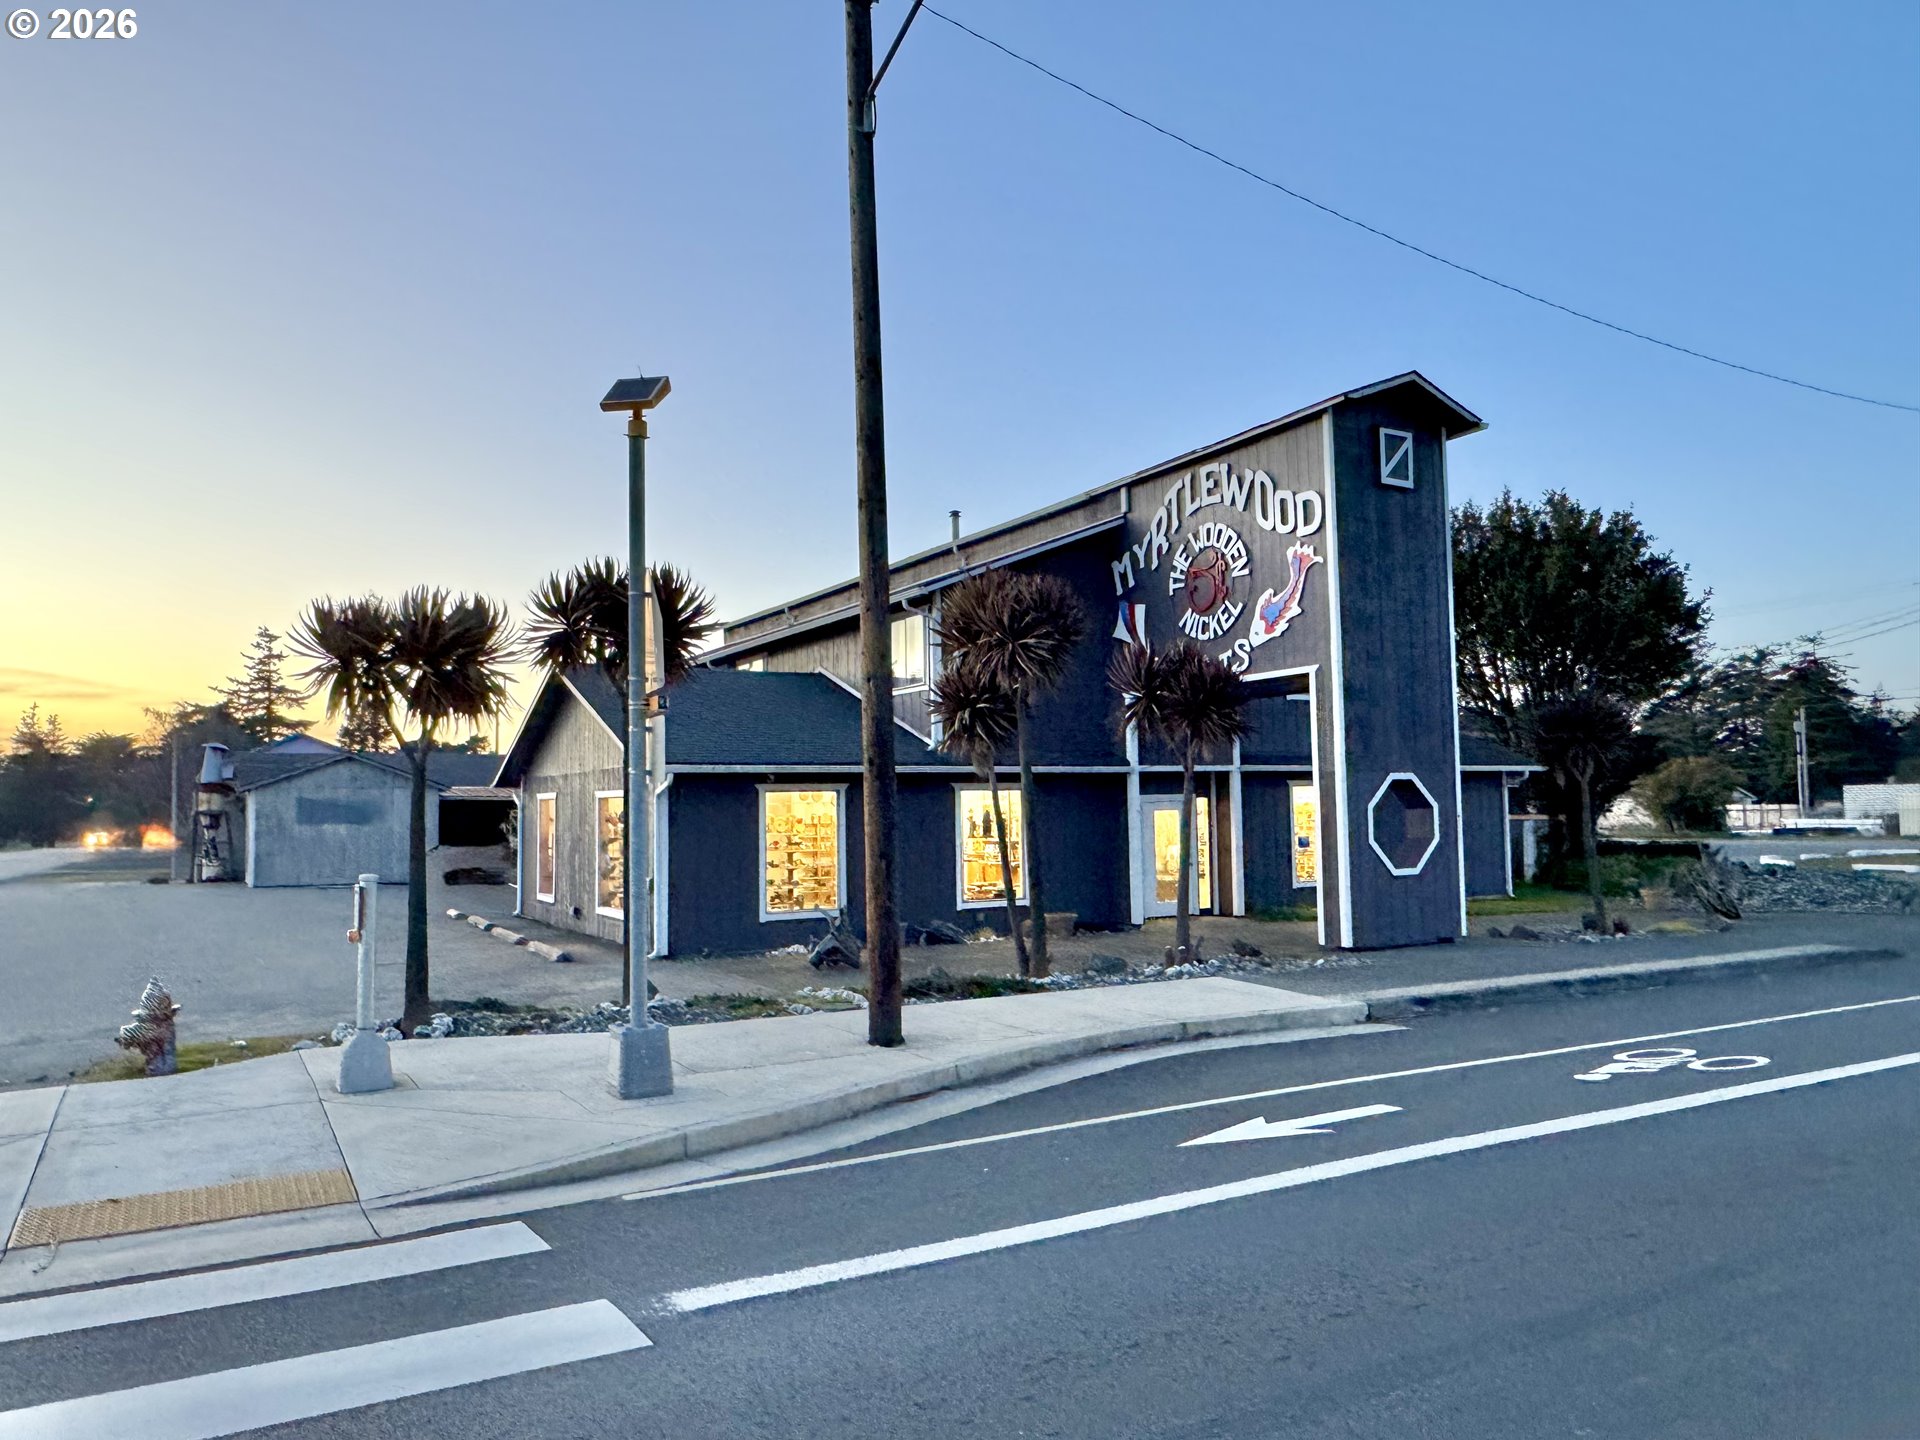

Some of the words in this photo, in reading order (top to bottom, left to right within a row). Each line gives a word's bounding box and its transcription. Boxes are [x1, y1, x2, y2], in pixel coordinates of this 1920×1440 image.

[1110, 462, 1323, 597] MYRTLEWOOD
[1169, 543, 1193, 596] THE
[1187, 521, 1250, 578] WOODEN
[1178, 599, 1244, 641] NICKEL
